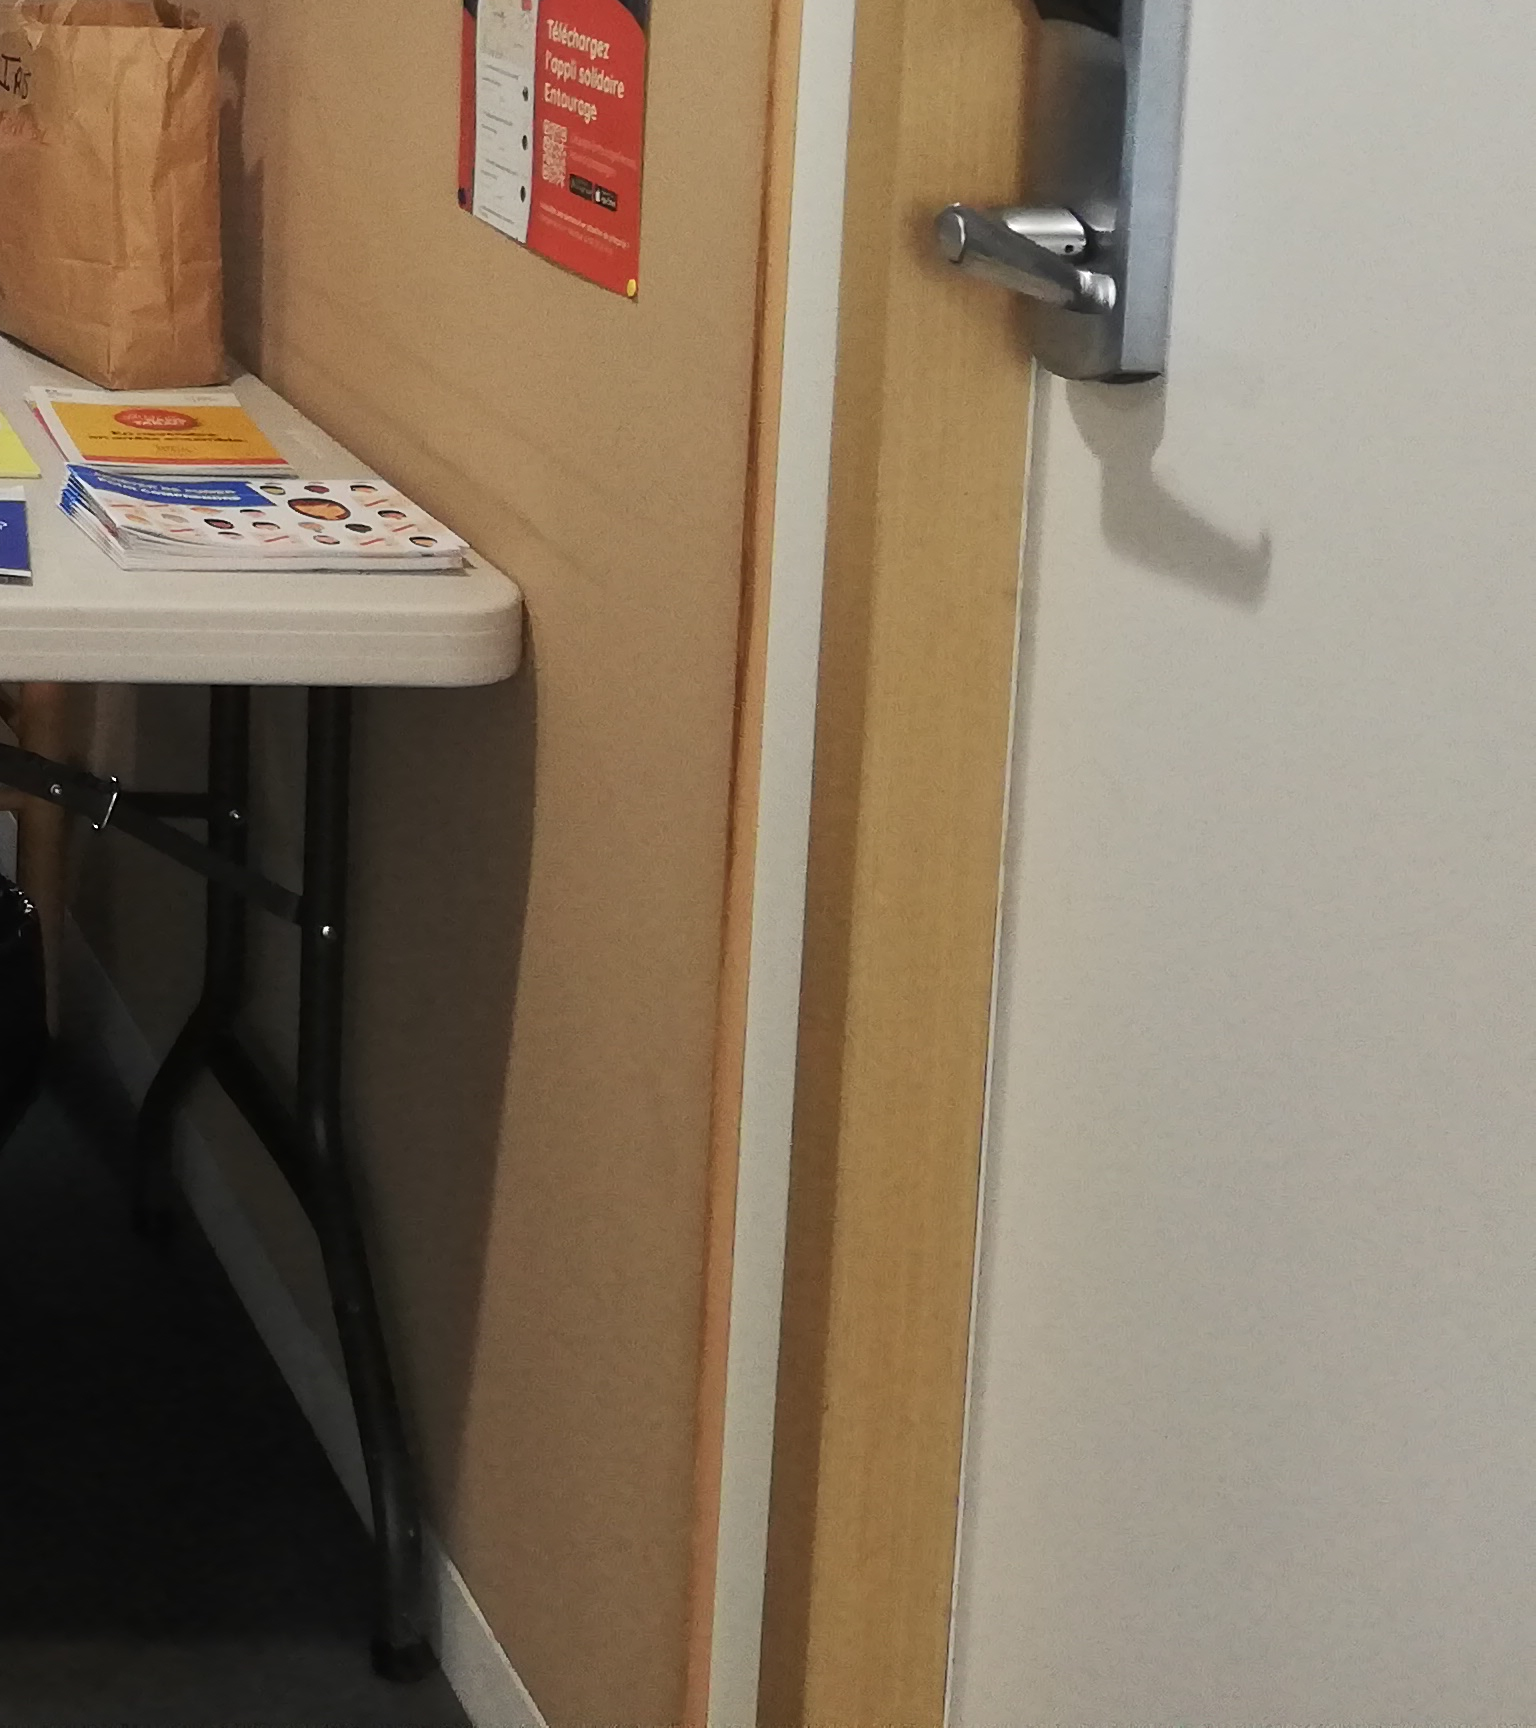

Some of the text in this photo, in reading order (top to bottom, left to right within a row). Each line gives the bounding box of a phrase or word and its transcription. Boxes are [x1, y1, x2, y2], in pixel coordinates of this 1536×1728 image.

[547, 18, 610, 60] Téléchargez
[544, 50, 625, 99] l'appli solidaire
[544, 82, 598, 124] Entourage
